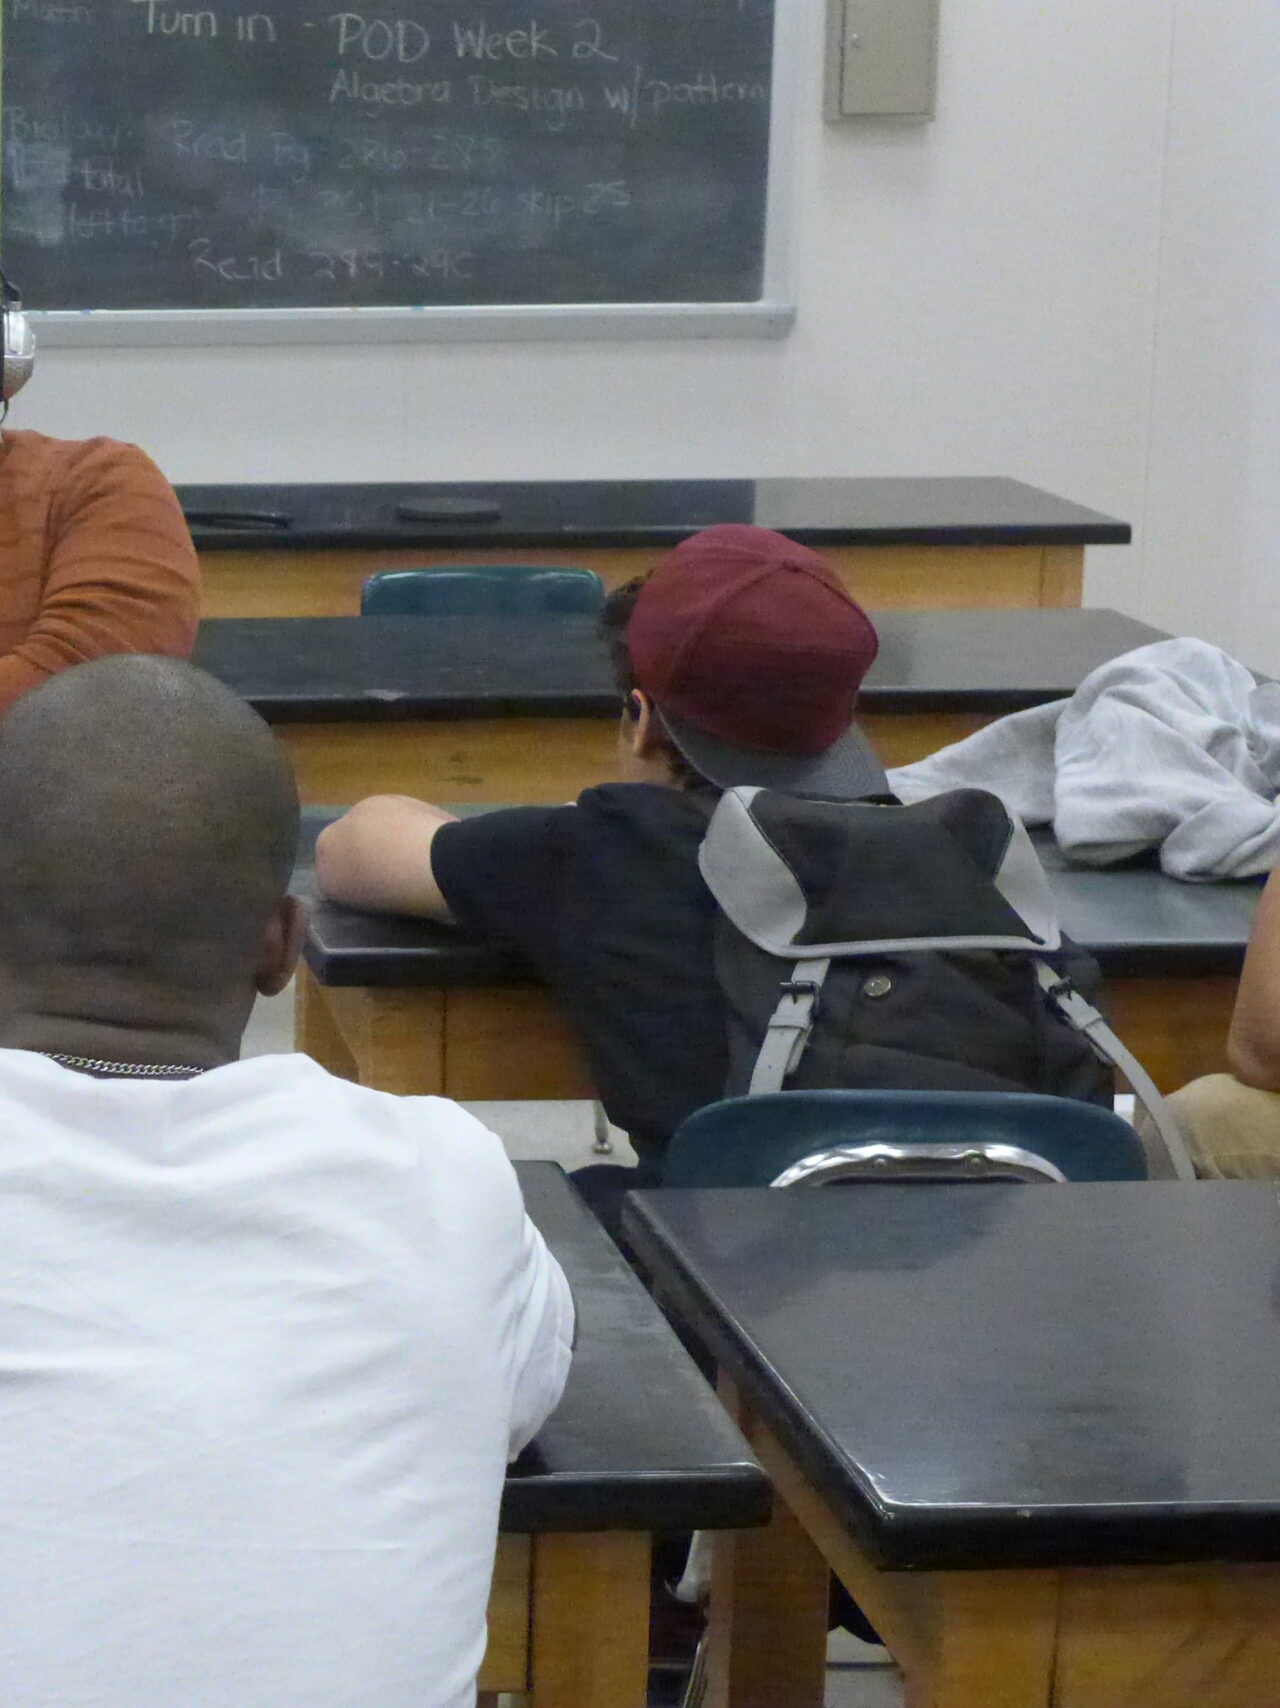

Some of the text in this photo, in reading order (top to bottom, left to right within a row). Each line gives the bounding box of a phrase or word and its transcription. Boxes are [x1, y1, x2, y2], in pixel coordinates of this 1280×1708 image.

[131, 0, 217, 37] Turn
[237, 13, 276, 41] in
[329, 13, 430, 62] POD
[453, 20, 558, 60] Week
[572, 18, 618, 61] 2
[328, 68, 451, 117] Algebra
[467, 74, 585, 131] Design
